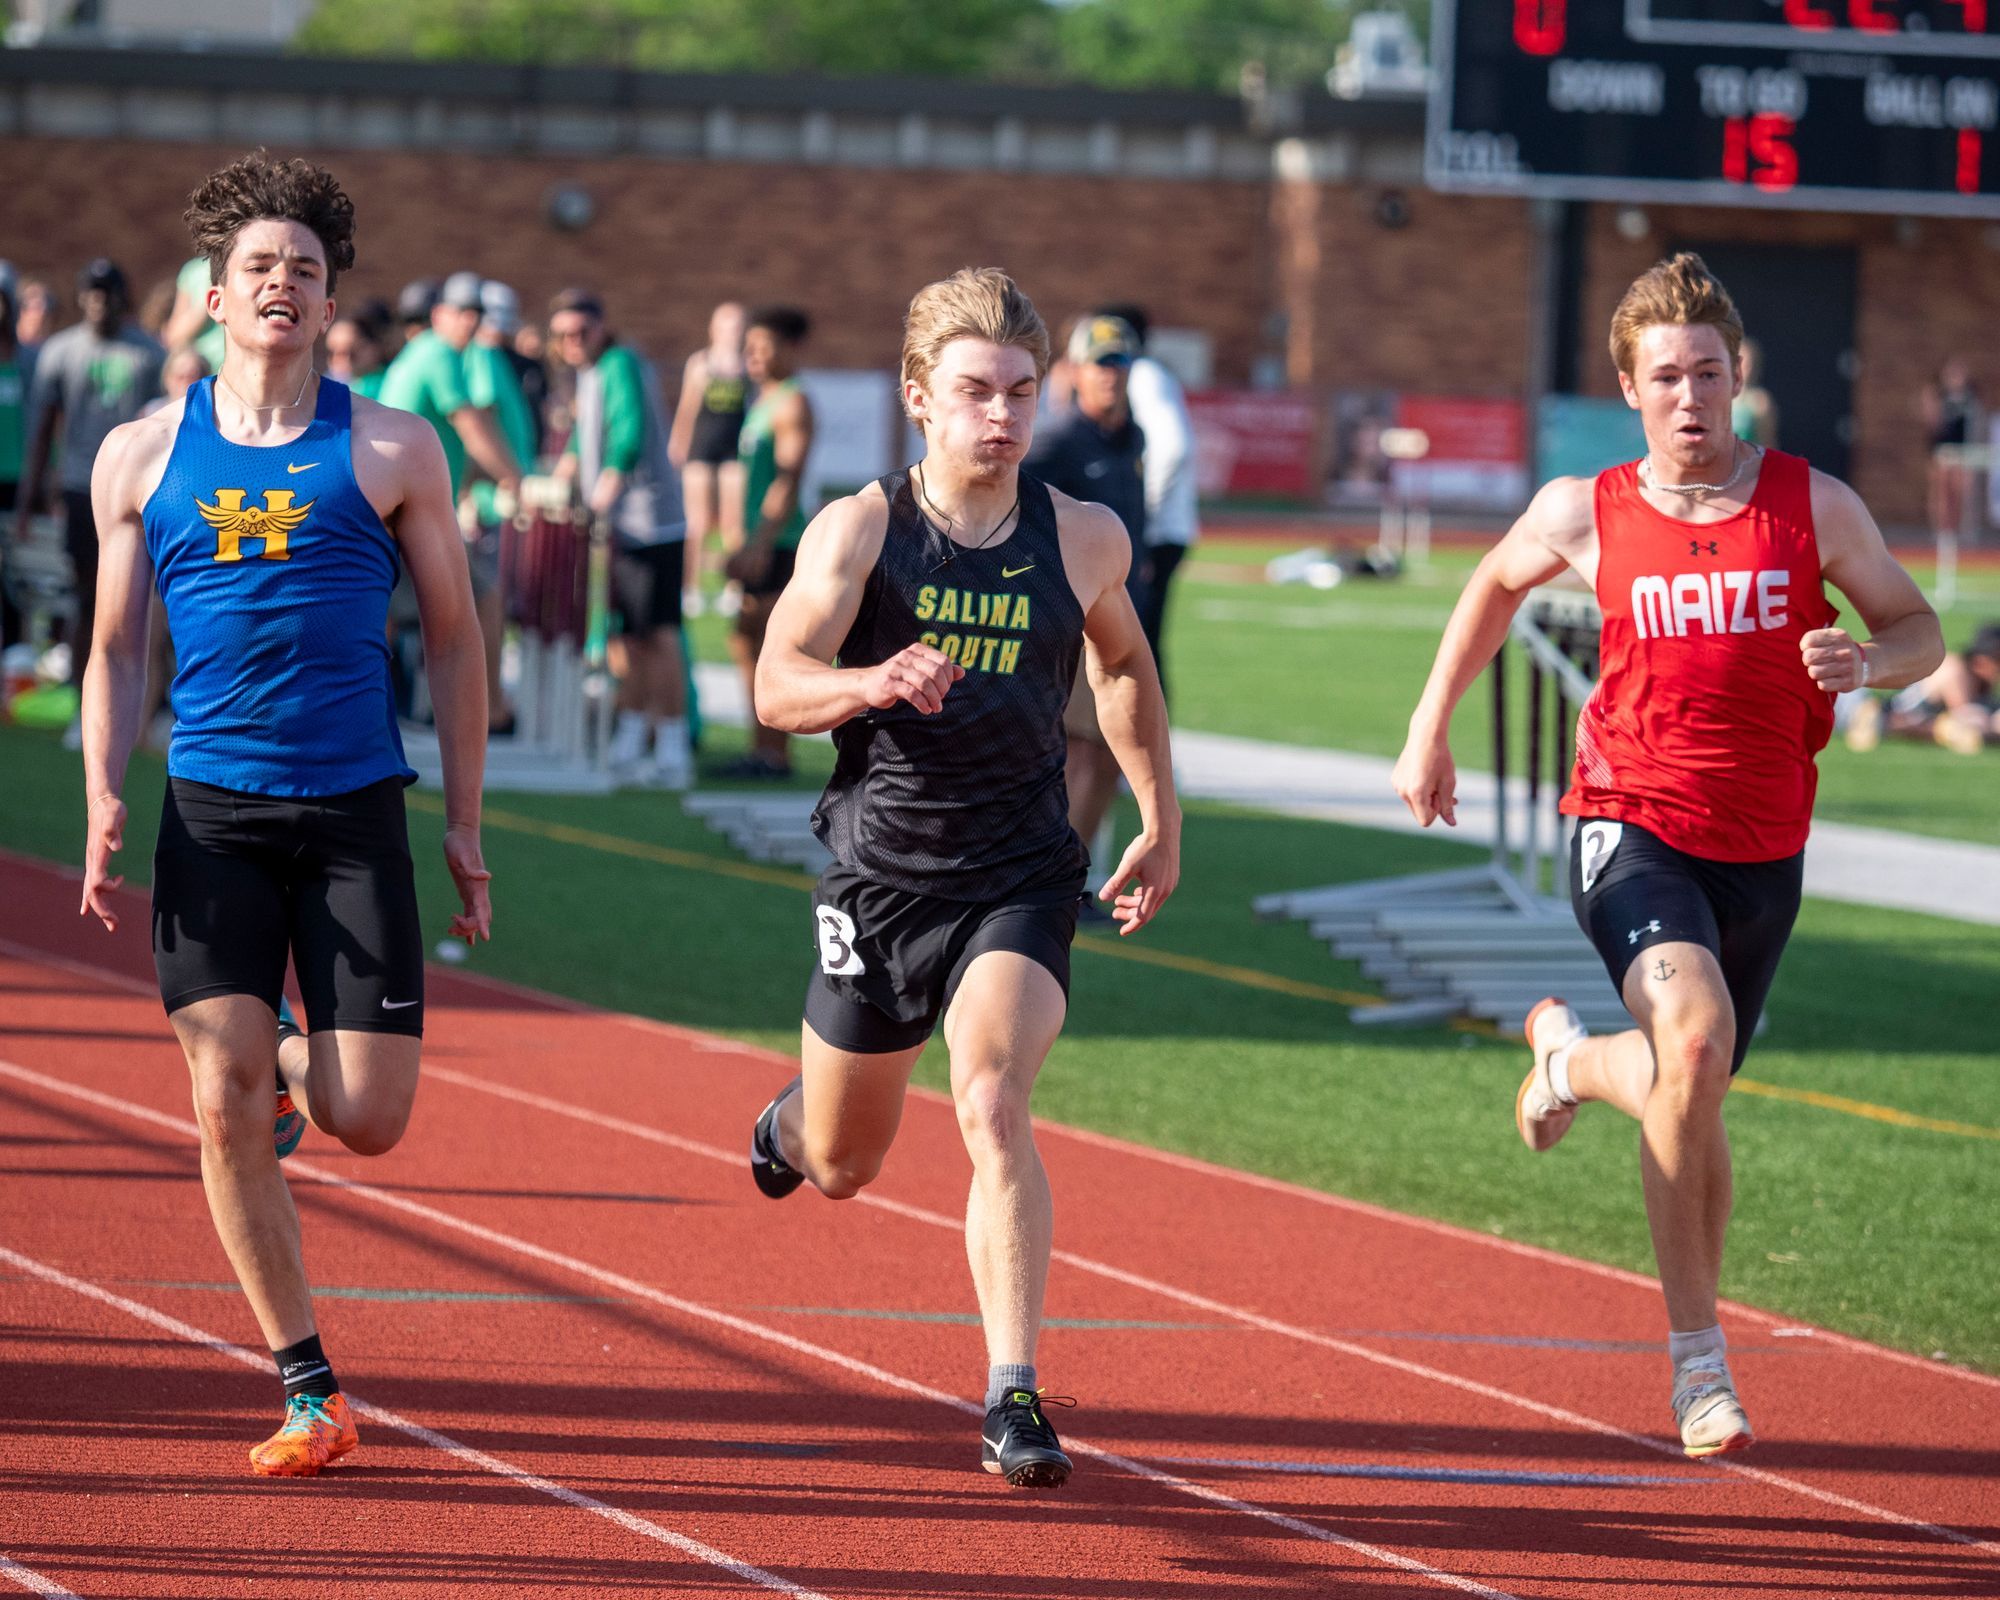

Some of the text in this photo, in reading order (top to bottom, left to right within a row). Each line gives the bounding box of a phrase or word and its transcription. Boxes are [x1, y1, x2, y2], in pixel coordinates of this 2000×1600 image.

[1722, 111, 1798, 193] 15
[1956, 126, 1981, 195] 1
[213, 488, 296, 562] H
[915, 584, 1031, 631] SALINA
[1631, 570, 1790, 639] MAIZE
